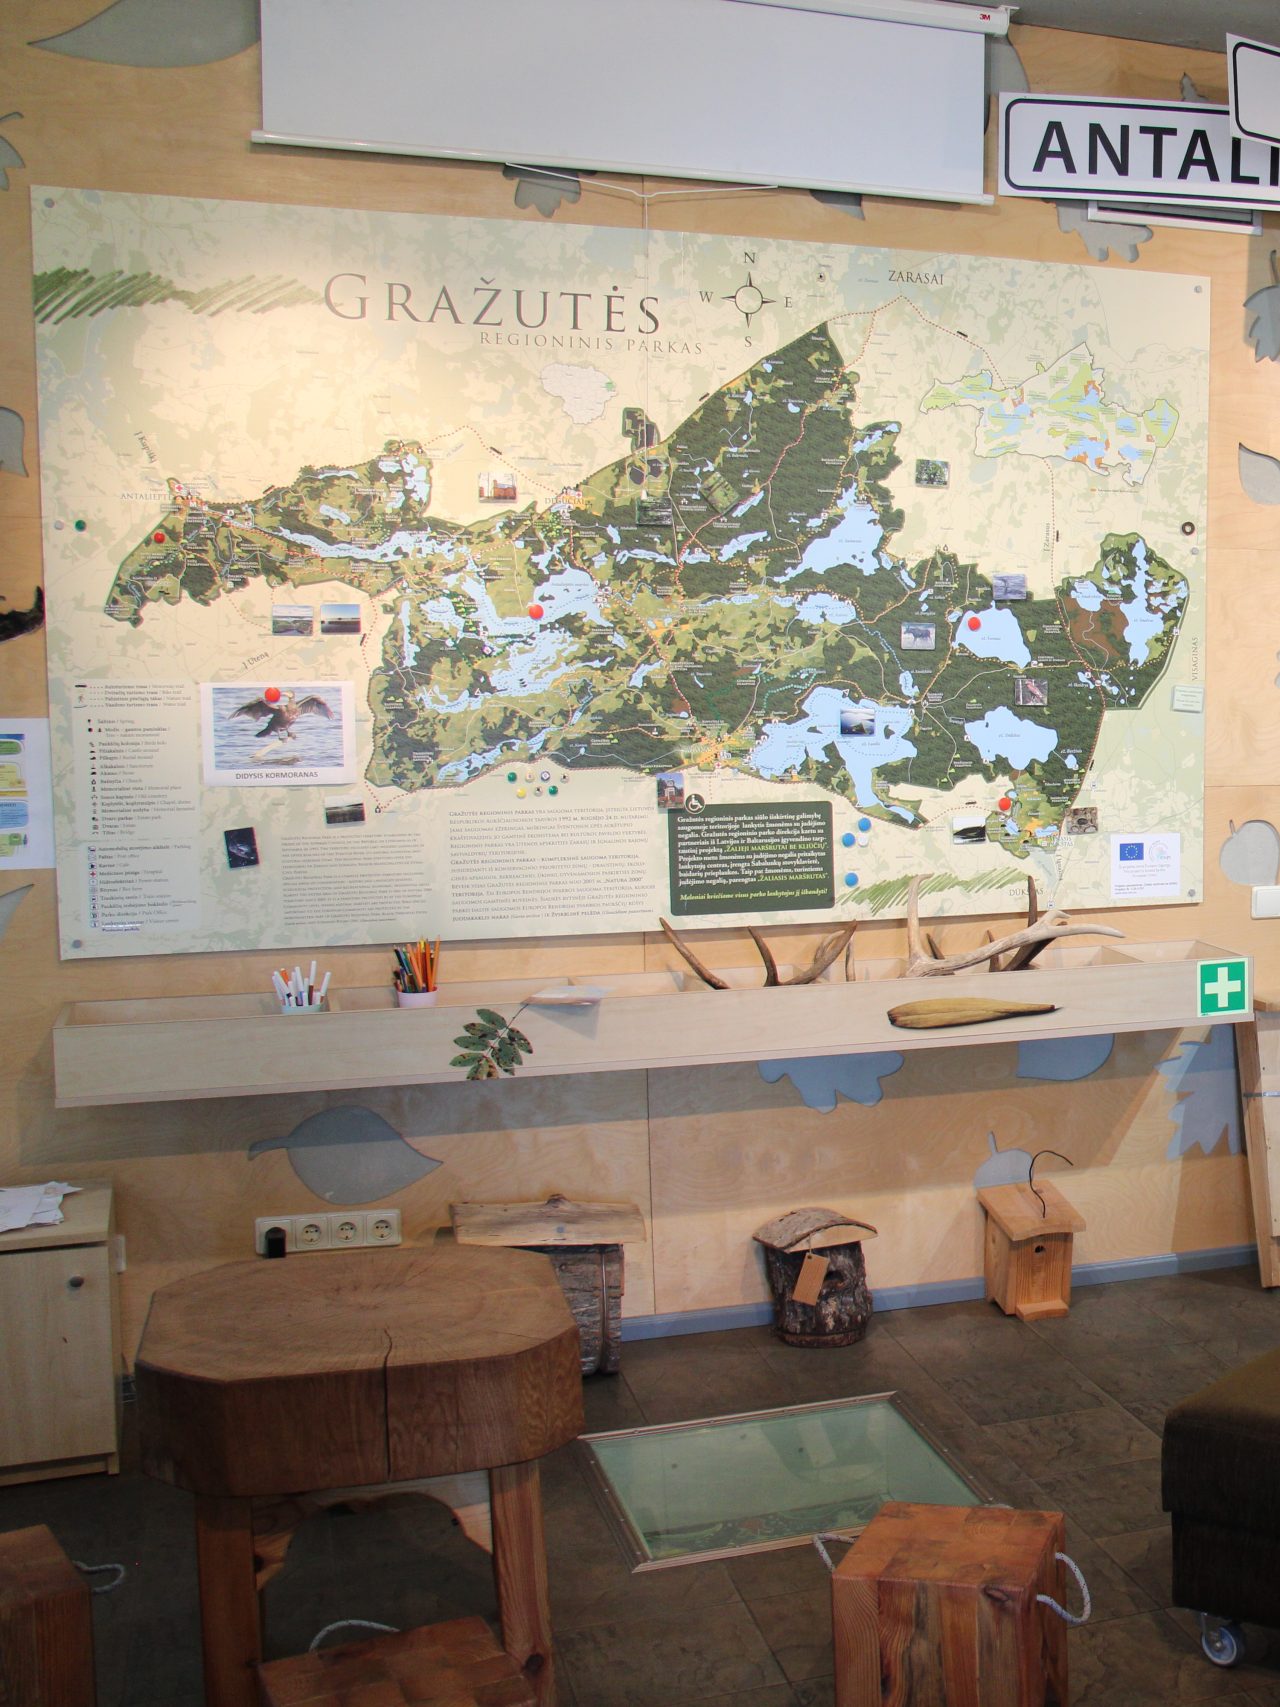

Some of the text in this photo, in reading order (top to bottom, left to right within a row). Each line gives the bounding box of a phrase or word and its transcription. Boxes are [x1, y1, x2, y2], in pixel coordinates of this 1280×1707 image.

[744, 251, 756, 264] N
[888, 269, 944, 285] ZARASAI
[324, 272, 660, 335] GRAŽUTĖS
[699, 290, 714, 303] W
[784, 296, 793, 308] E
[480, 331, 703, 355] REGIONINIS PARKAS
[745, 335, 752, 348] S
[1191, 636, 1199, 681] VISAGINAS
